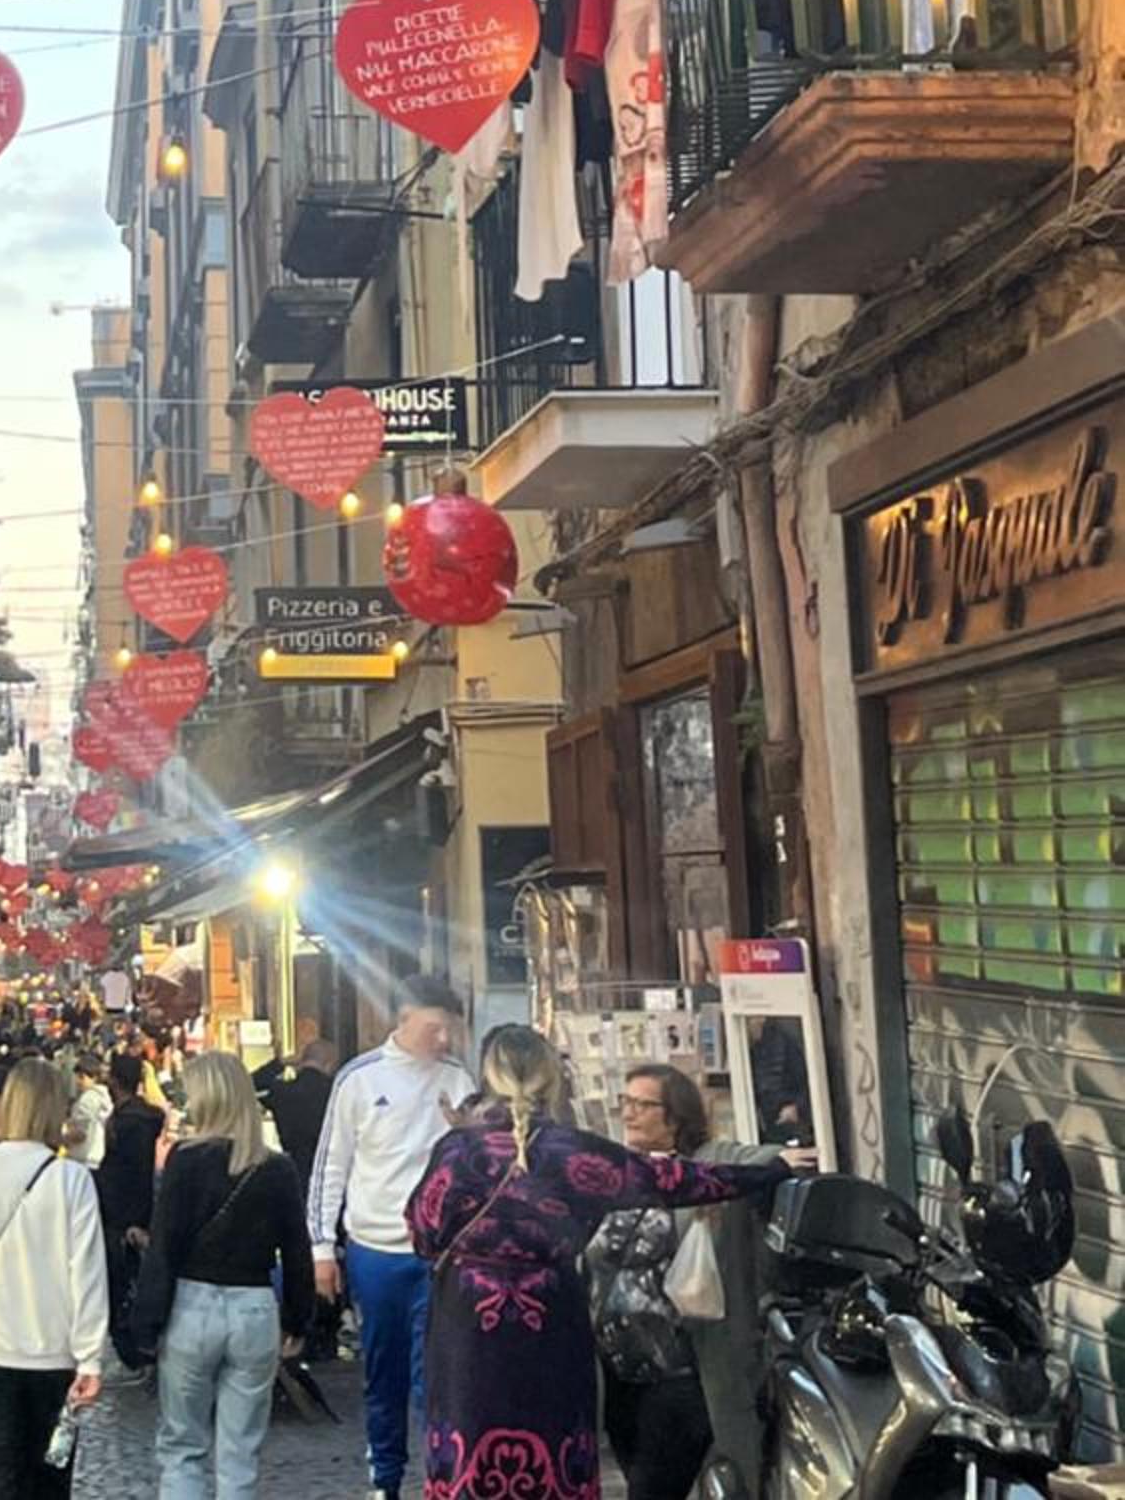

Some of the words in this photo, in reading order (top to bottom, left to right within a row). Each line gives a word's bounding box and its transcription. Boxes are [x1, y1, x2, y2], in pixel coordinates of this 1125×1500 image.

[267, 595, 359, 618] Pizzeria
[368, 599, 383, 618] e
[264, 627, 388, 655] Friggitoria
